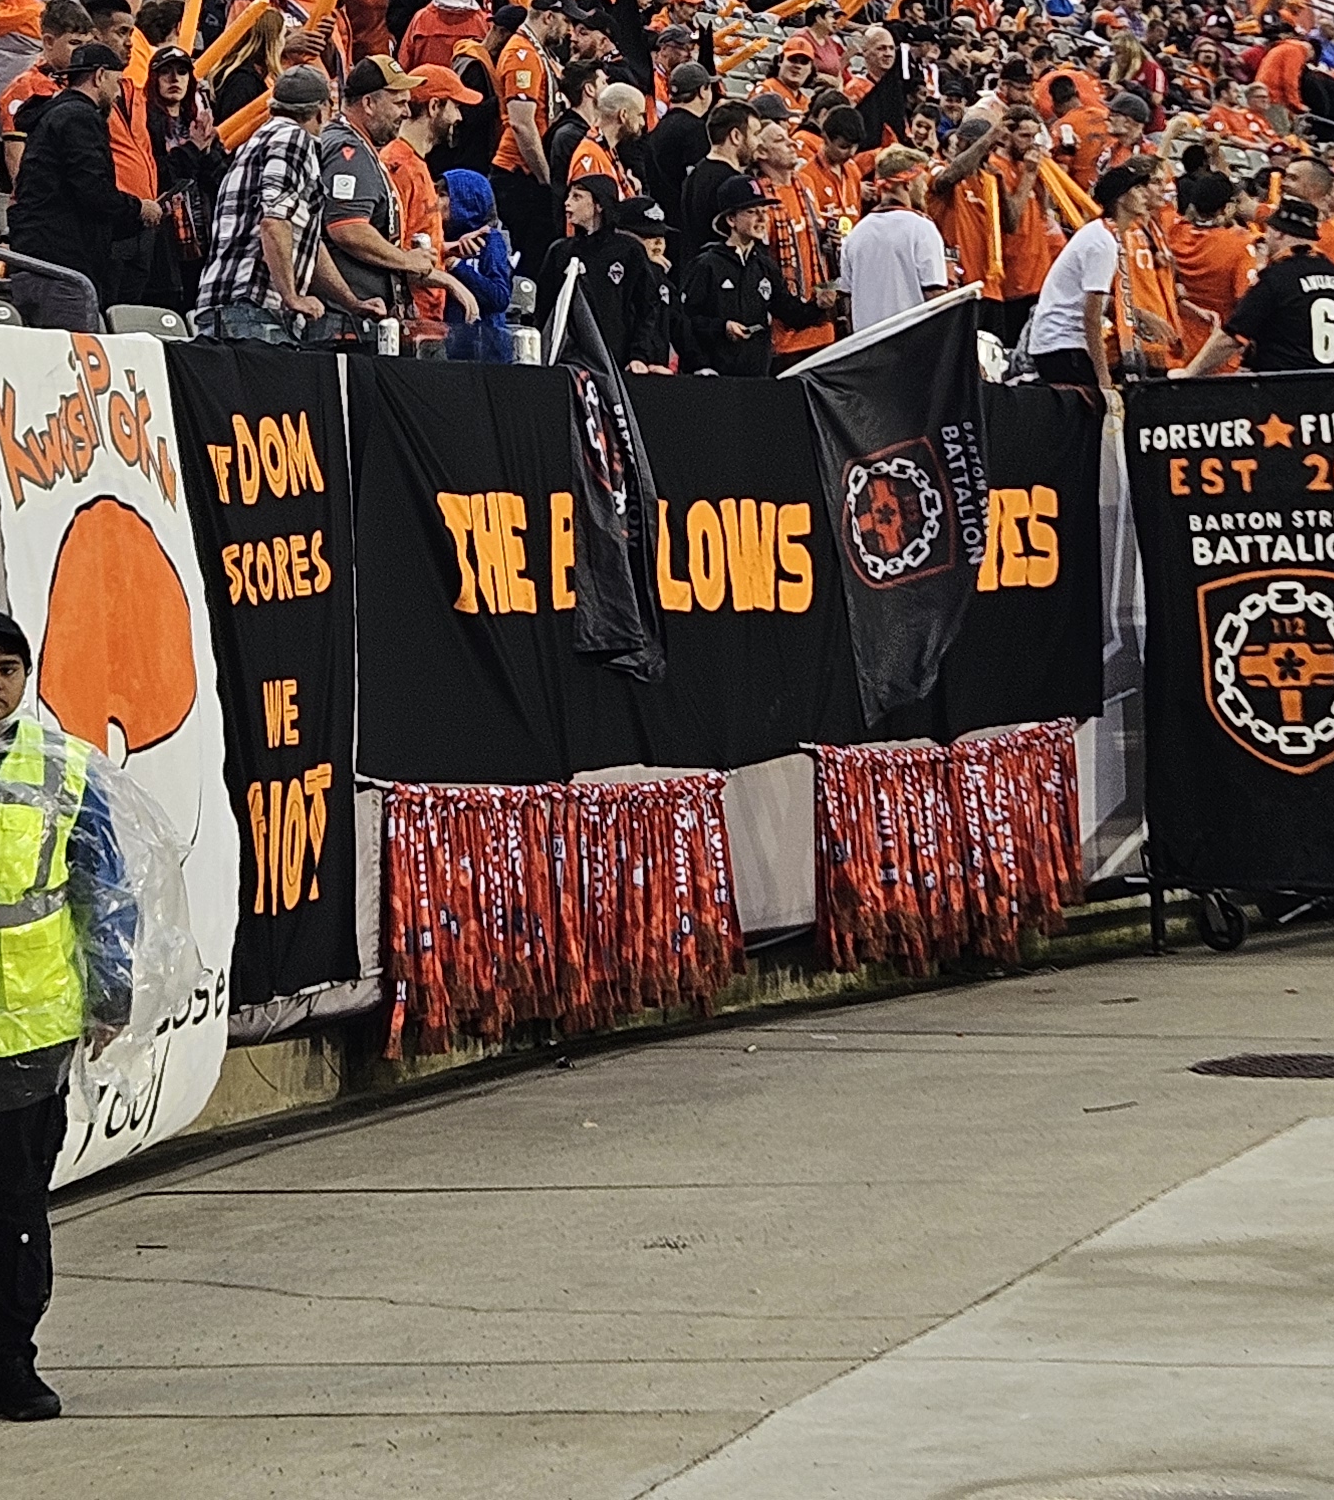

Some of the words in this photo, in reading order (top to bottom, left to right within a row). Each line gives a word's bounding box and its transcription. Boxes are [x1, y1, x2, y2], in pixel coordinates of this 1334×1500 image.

[231, 410, 325, 505] DOM
[963, 421, 988, 491] BARTON
[1139, 418, 1255, 454] FOREVER
[941, 424, 986, 566] BATTALION
[1170, 457, 1258, 495] EST
[437, 492, 537, 615] THE
[1188, 511, 1283, 532] BARTON
[222, 529, 332, 606] SCORES
[263, 679, 299, 749] WE
